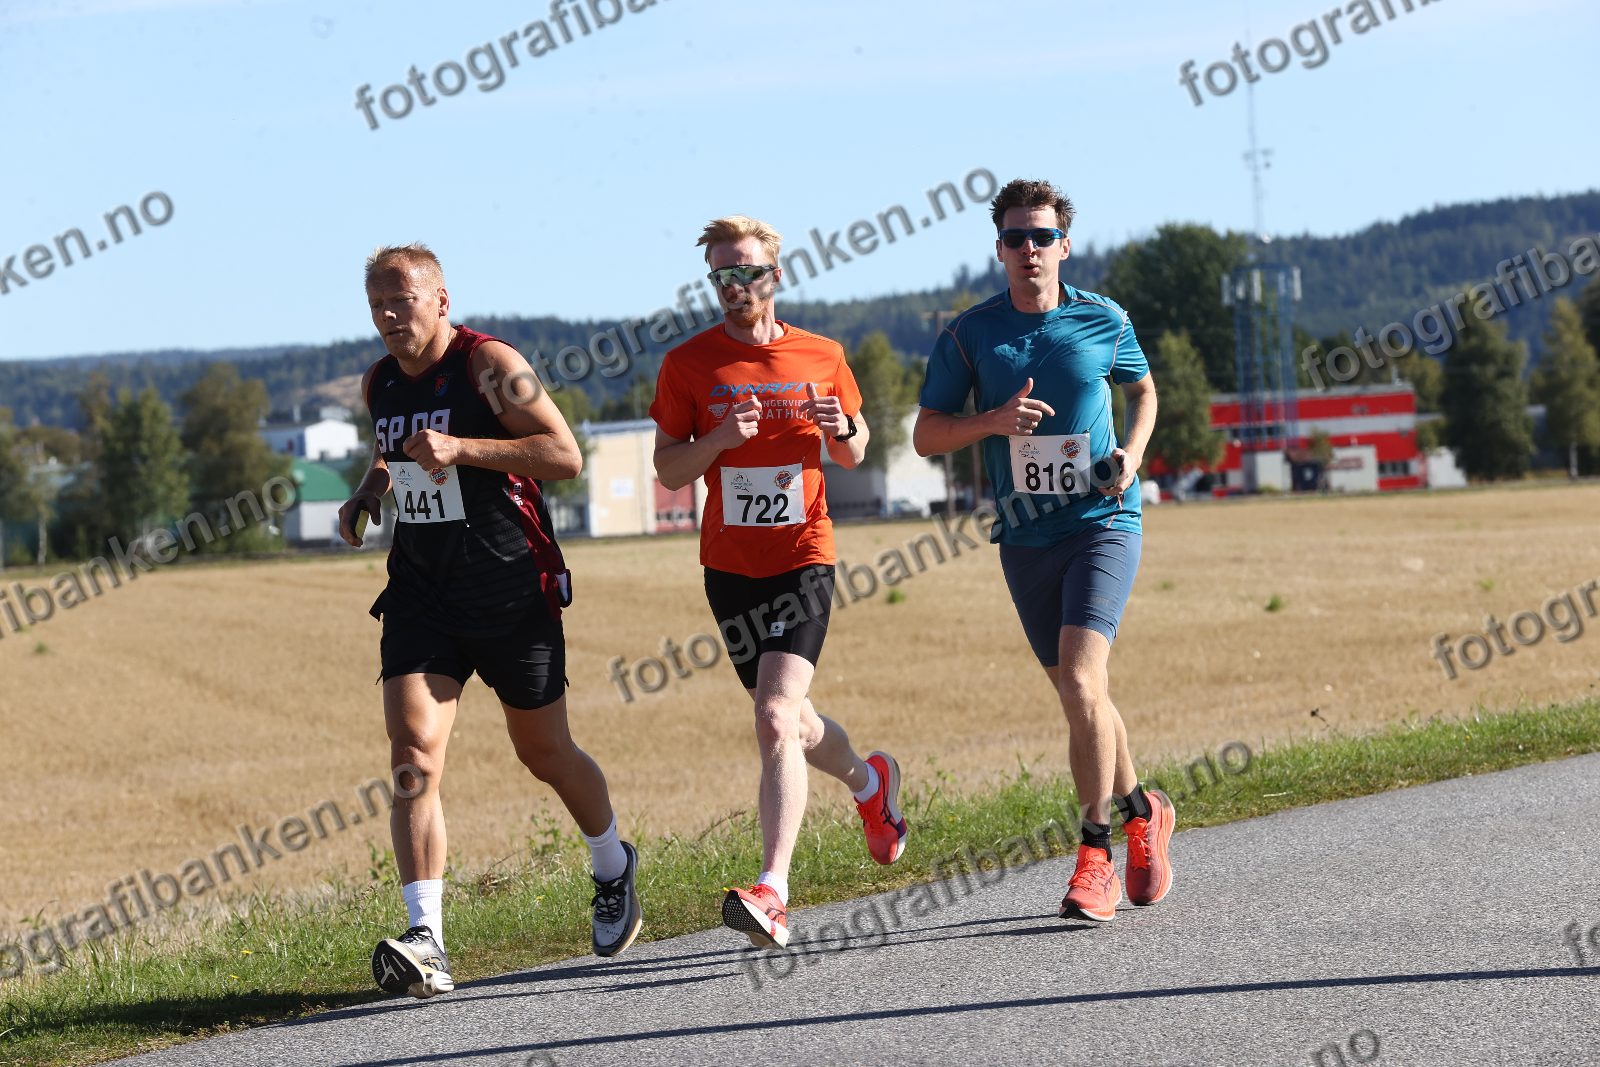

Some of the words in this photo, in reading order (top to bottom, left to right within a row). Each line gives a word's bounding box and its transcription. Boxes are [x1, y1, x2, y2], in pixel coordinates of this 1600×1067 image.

[1025, 461, 1076, 492] 816
[404, 489, 446, 519] 441
[736, 493, 790, 523] 722
